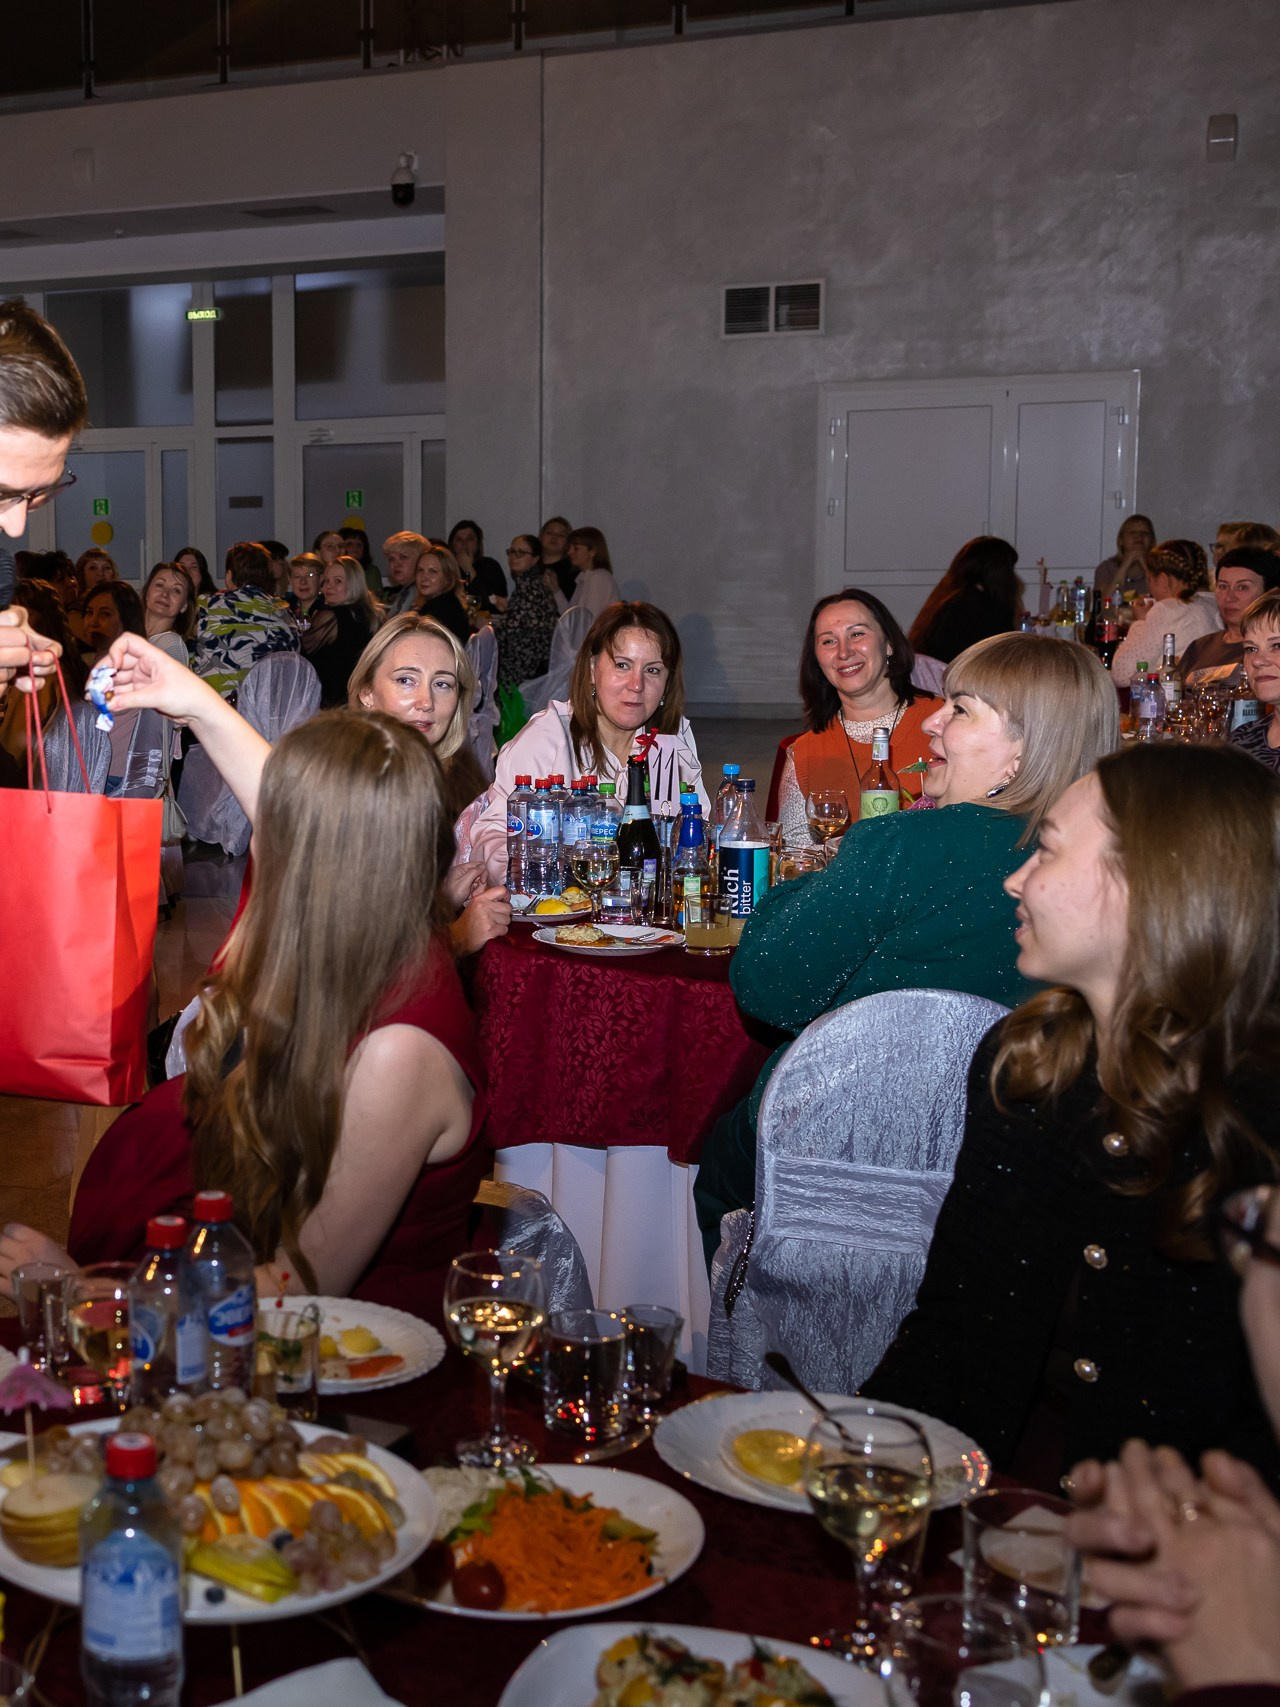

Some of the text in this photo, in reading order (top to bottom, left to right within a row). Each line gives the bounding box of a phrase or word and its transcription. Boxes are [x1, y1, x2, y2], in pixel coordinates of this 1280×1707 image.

[187, 310, 217, 320] ВЫХОД
[652, 747, 675, 802] 11
[739, 880, 752, 915] bitter
